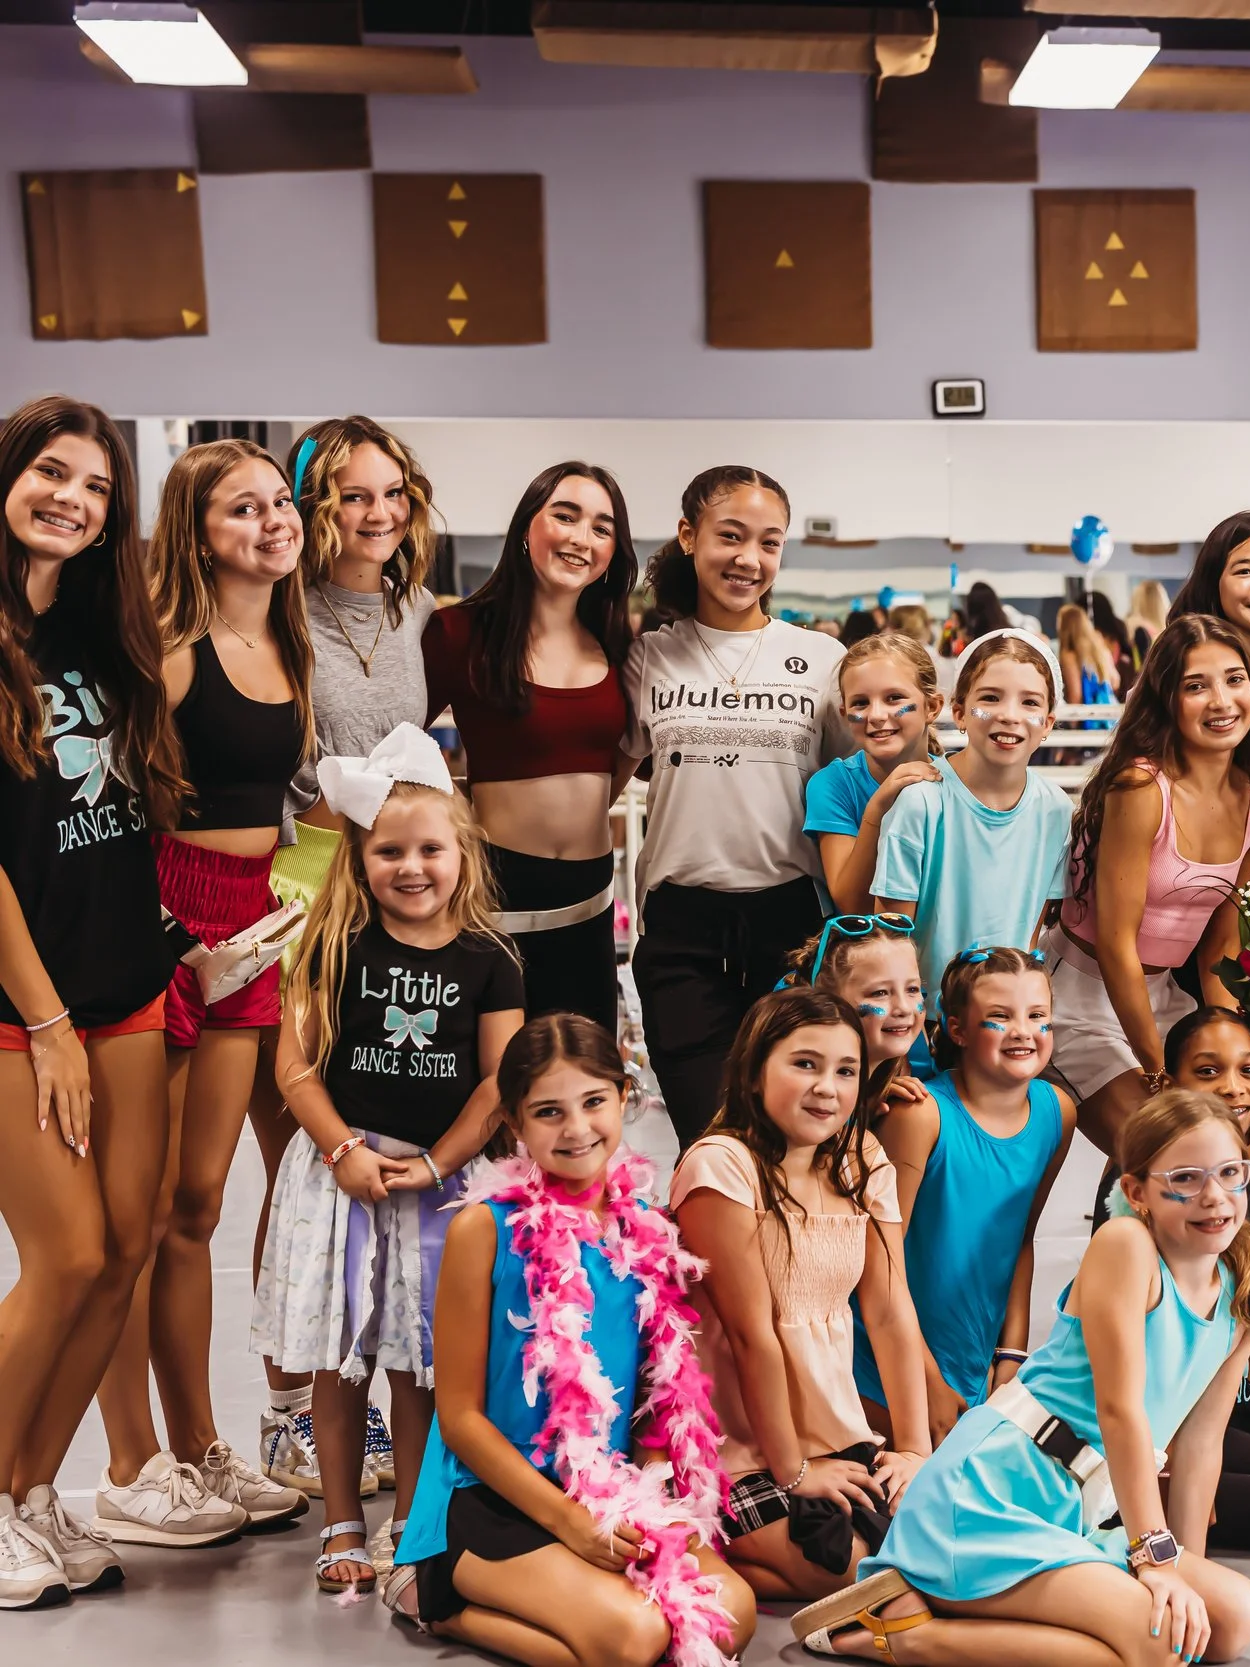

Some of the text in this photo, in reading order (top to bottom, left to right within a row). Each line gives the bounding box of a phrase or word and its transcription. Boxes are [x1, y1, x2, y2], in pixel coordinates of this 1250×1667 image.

[33, 671, 110, 737] Bi
[651, 684, 815, 720] lululemon
[57, 804, 123, 853] DANCE
[361, 966, 460, 1006] Little
[351, 1047, 457, 1077] DANCE SISTER
